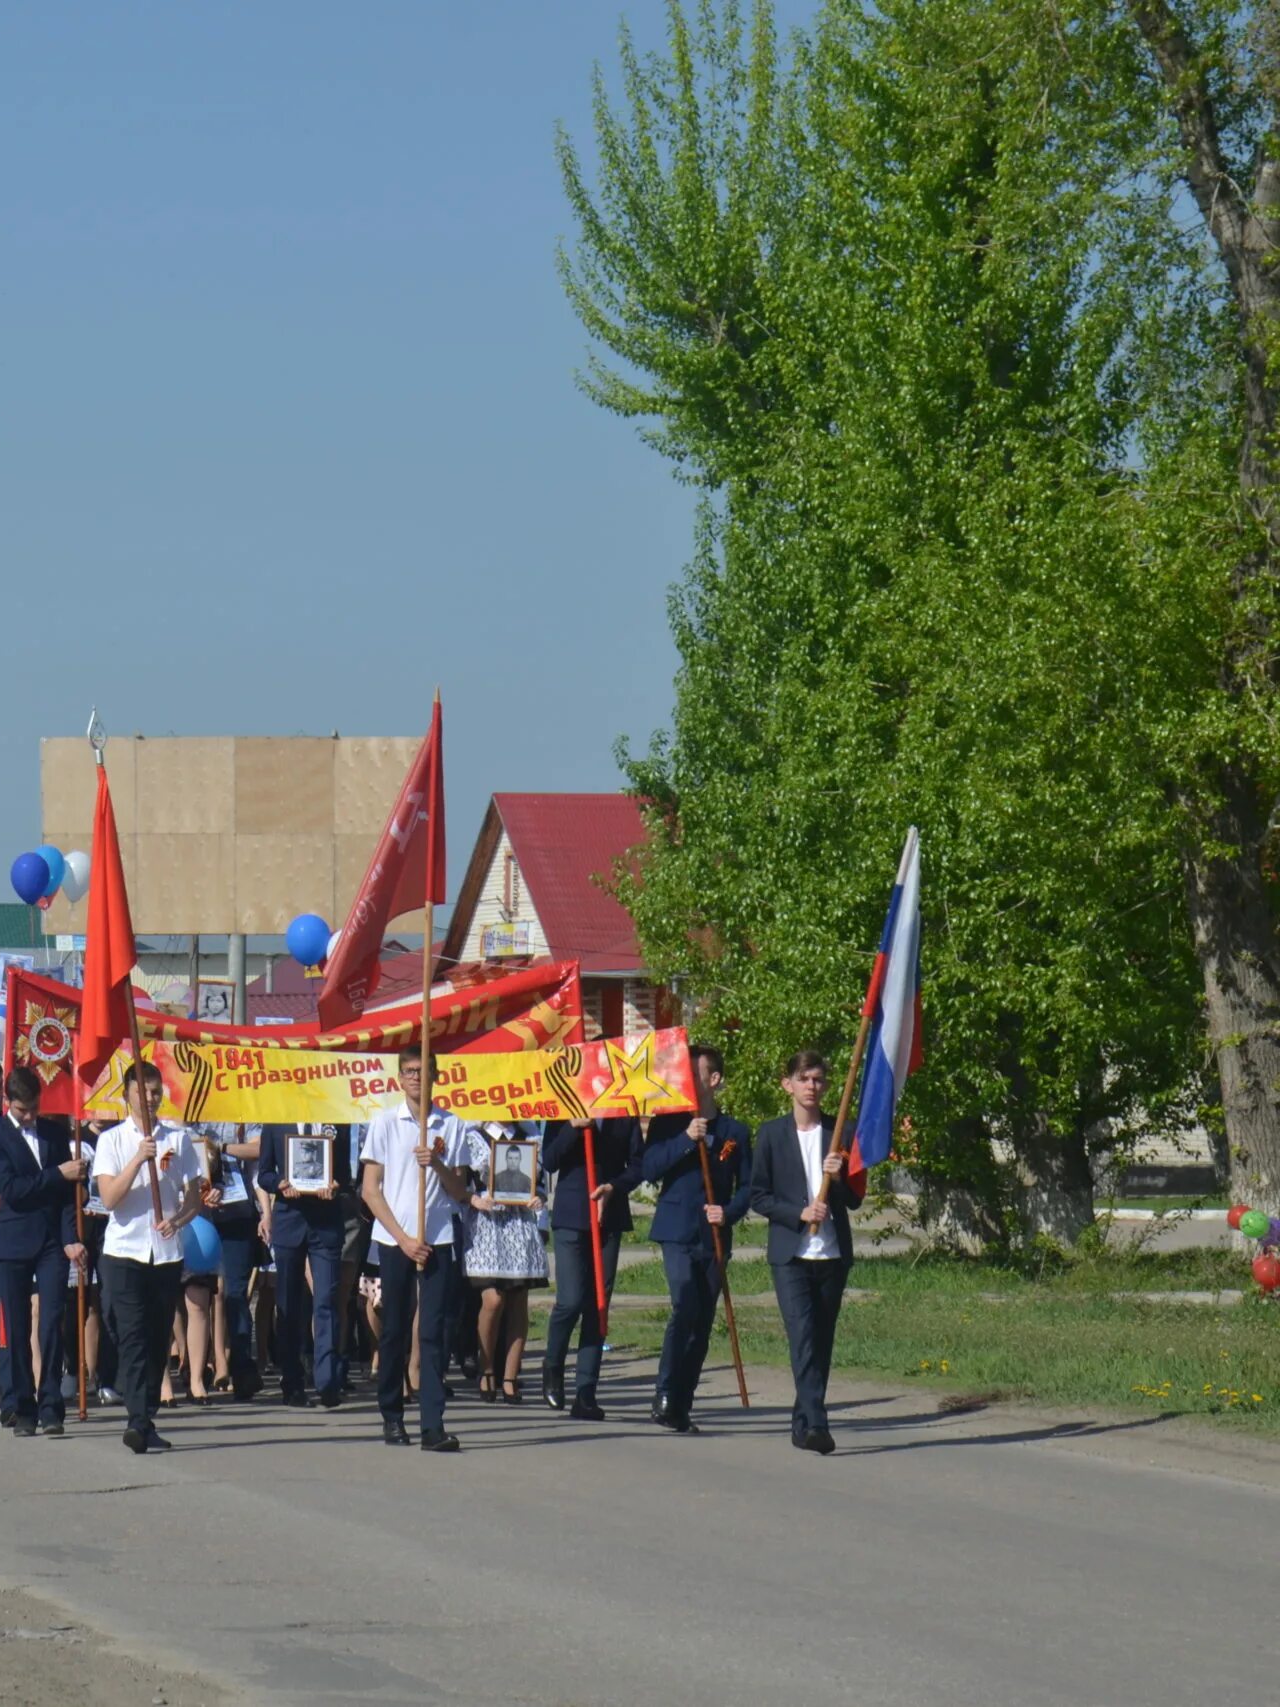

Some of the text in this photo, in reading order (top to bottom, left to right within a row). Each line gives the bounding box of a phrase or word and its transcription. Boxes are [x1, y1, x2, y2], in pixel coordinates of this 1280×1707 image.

[212, 1047, 265, 1070] 1941
[215, 1057, 384, 1092] С праздником
[349, 1062, 468, 1098] Велой
[432, 1071, 543, 1110] обеды!
[506, 1100, 559, 1119] 1945
